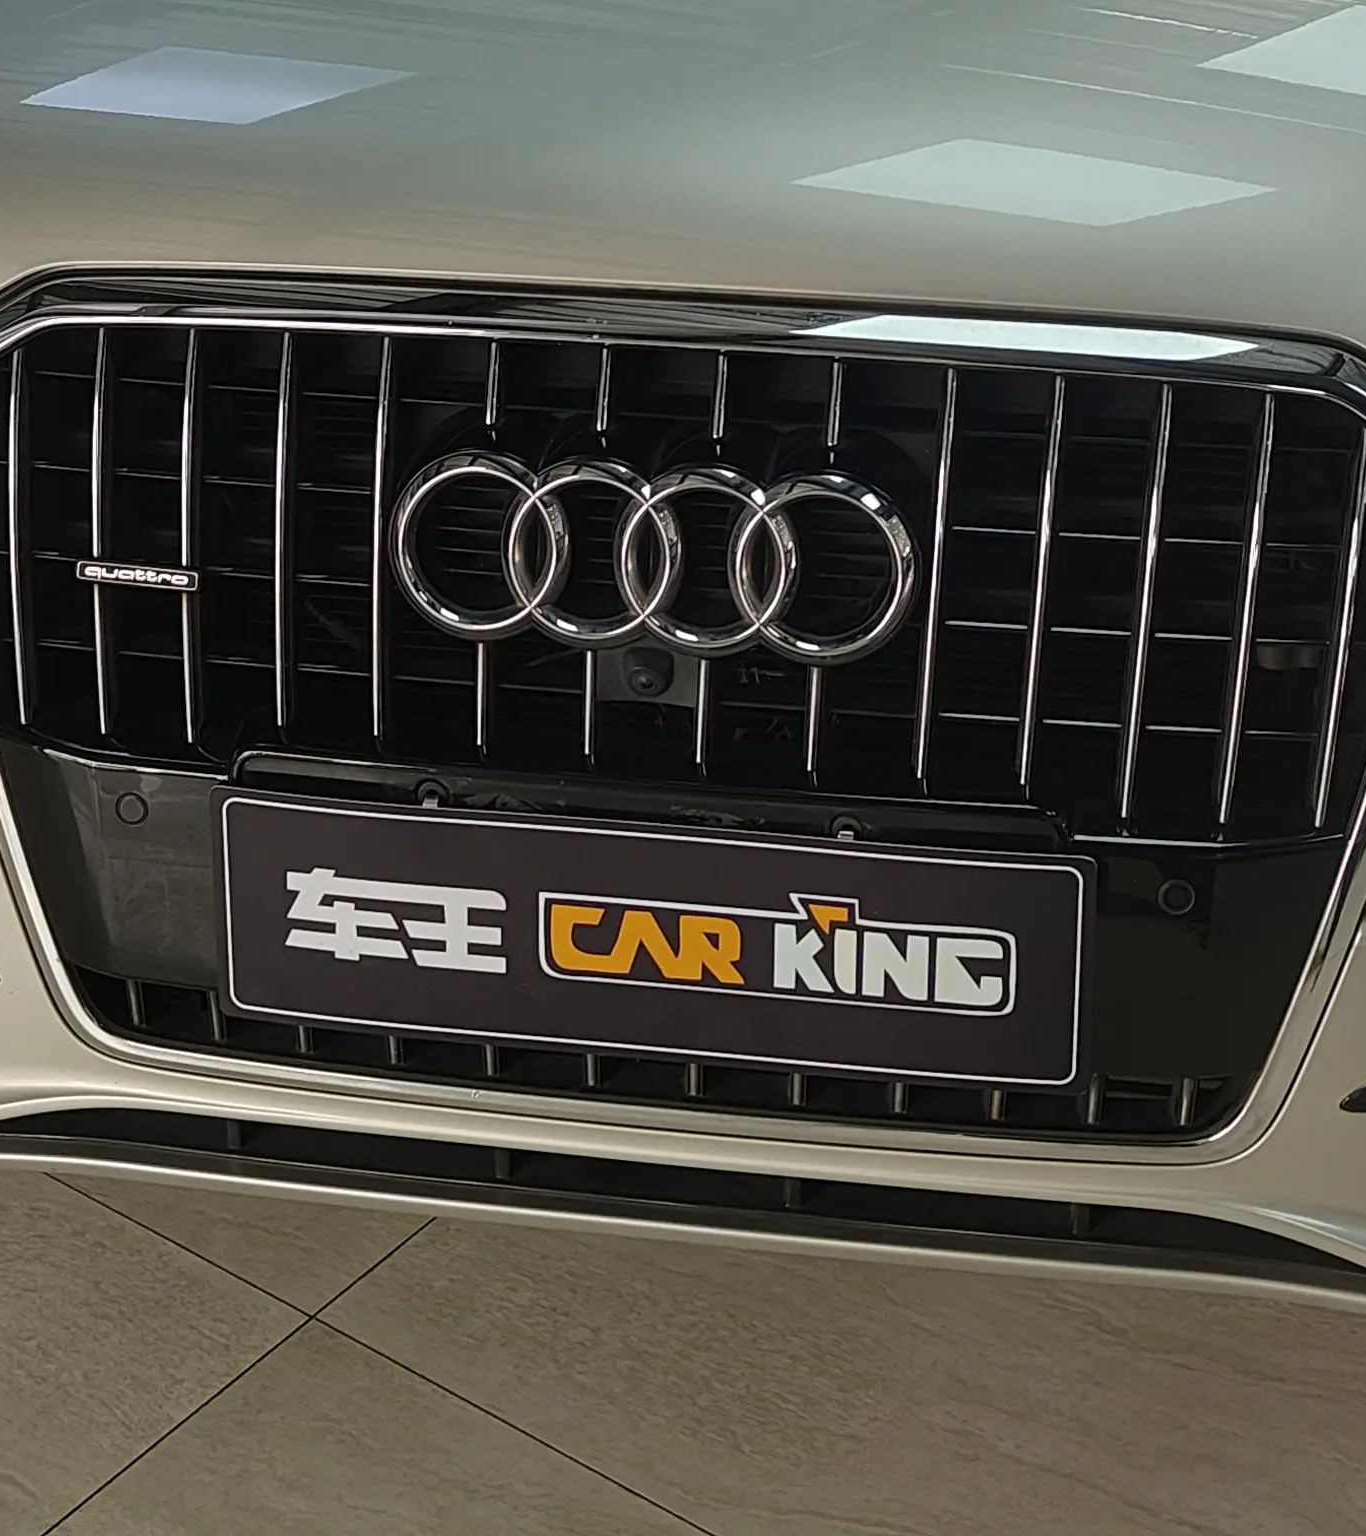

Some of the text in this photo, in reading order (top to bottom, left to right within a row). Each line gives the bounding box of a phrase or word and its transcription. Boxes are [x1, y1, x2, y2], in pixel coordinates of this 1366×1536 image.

[84, 566, 189, 586] quattro
[285, 866, 508, 975] 车王
[550, 902, 1003, 1007] CAR KING
